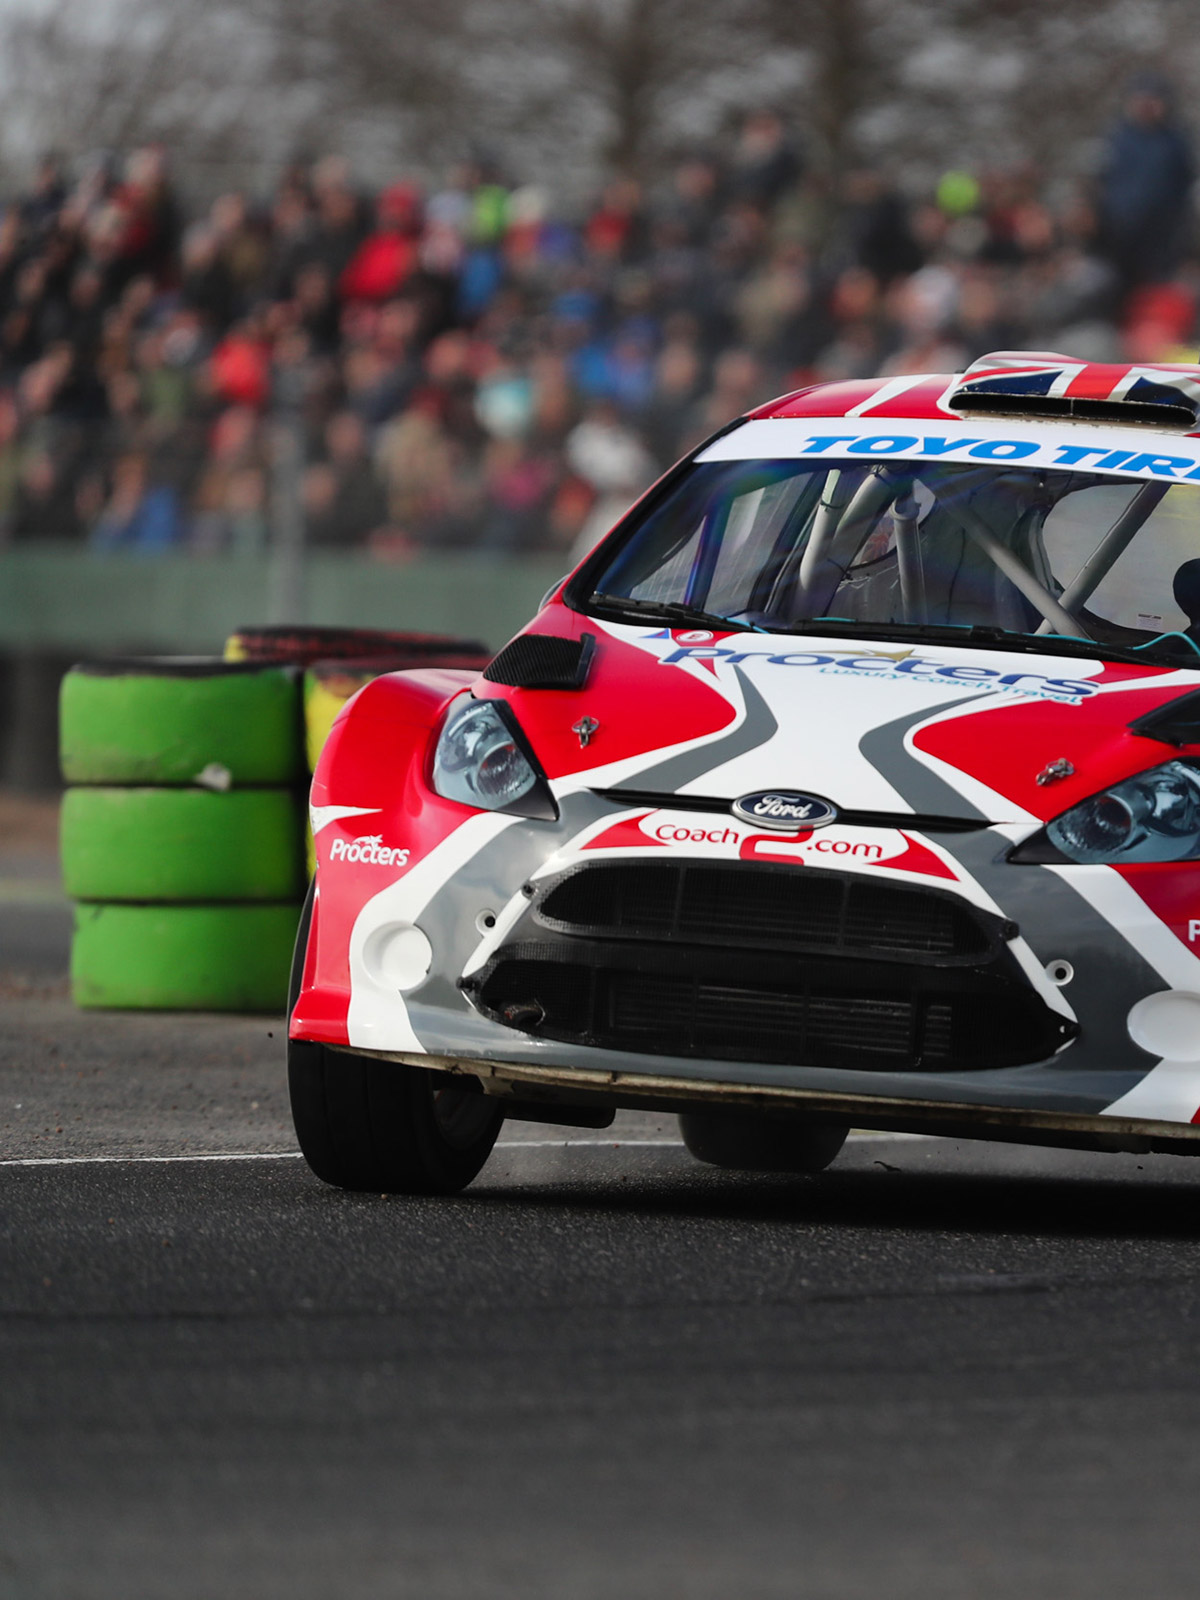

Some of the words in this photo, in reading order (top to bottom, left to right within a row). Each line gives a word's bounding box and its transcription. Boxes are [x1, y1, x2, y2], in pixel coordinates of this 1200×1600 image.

[800, 435, 1042, 460] TOYO
[662, 646, 1101, 697] Procters
[818, 667, 903, 680] Luxury
[912, 675, 993, 690] Coach
[1000, 684, 1083, 703] Travel
[753, 794, 811, 818] Ford
[329, 838, 410, 867] Procters
